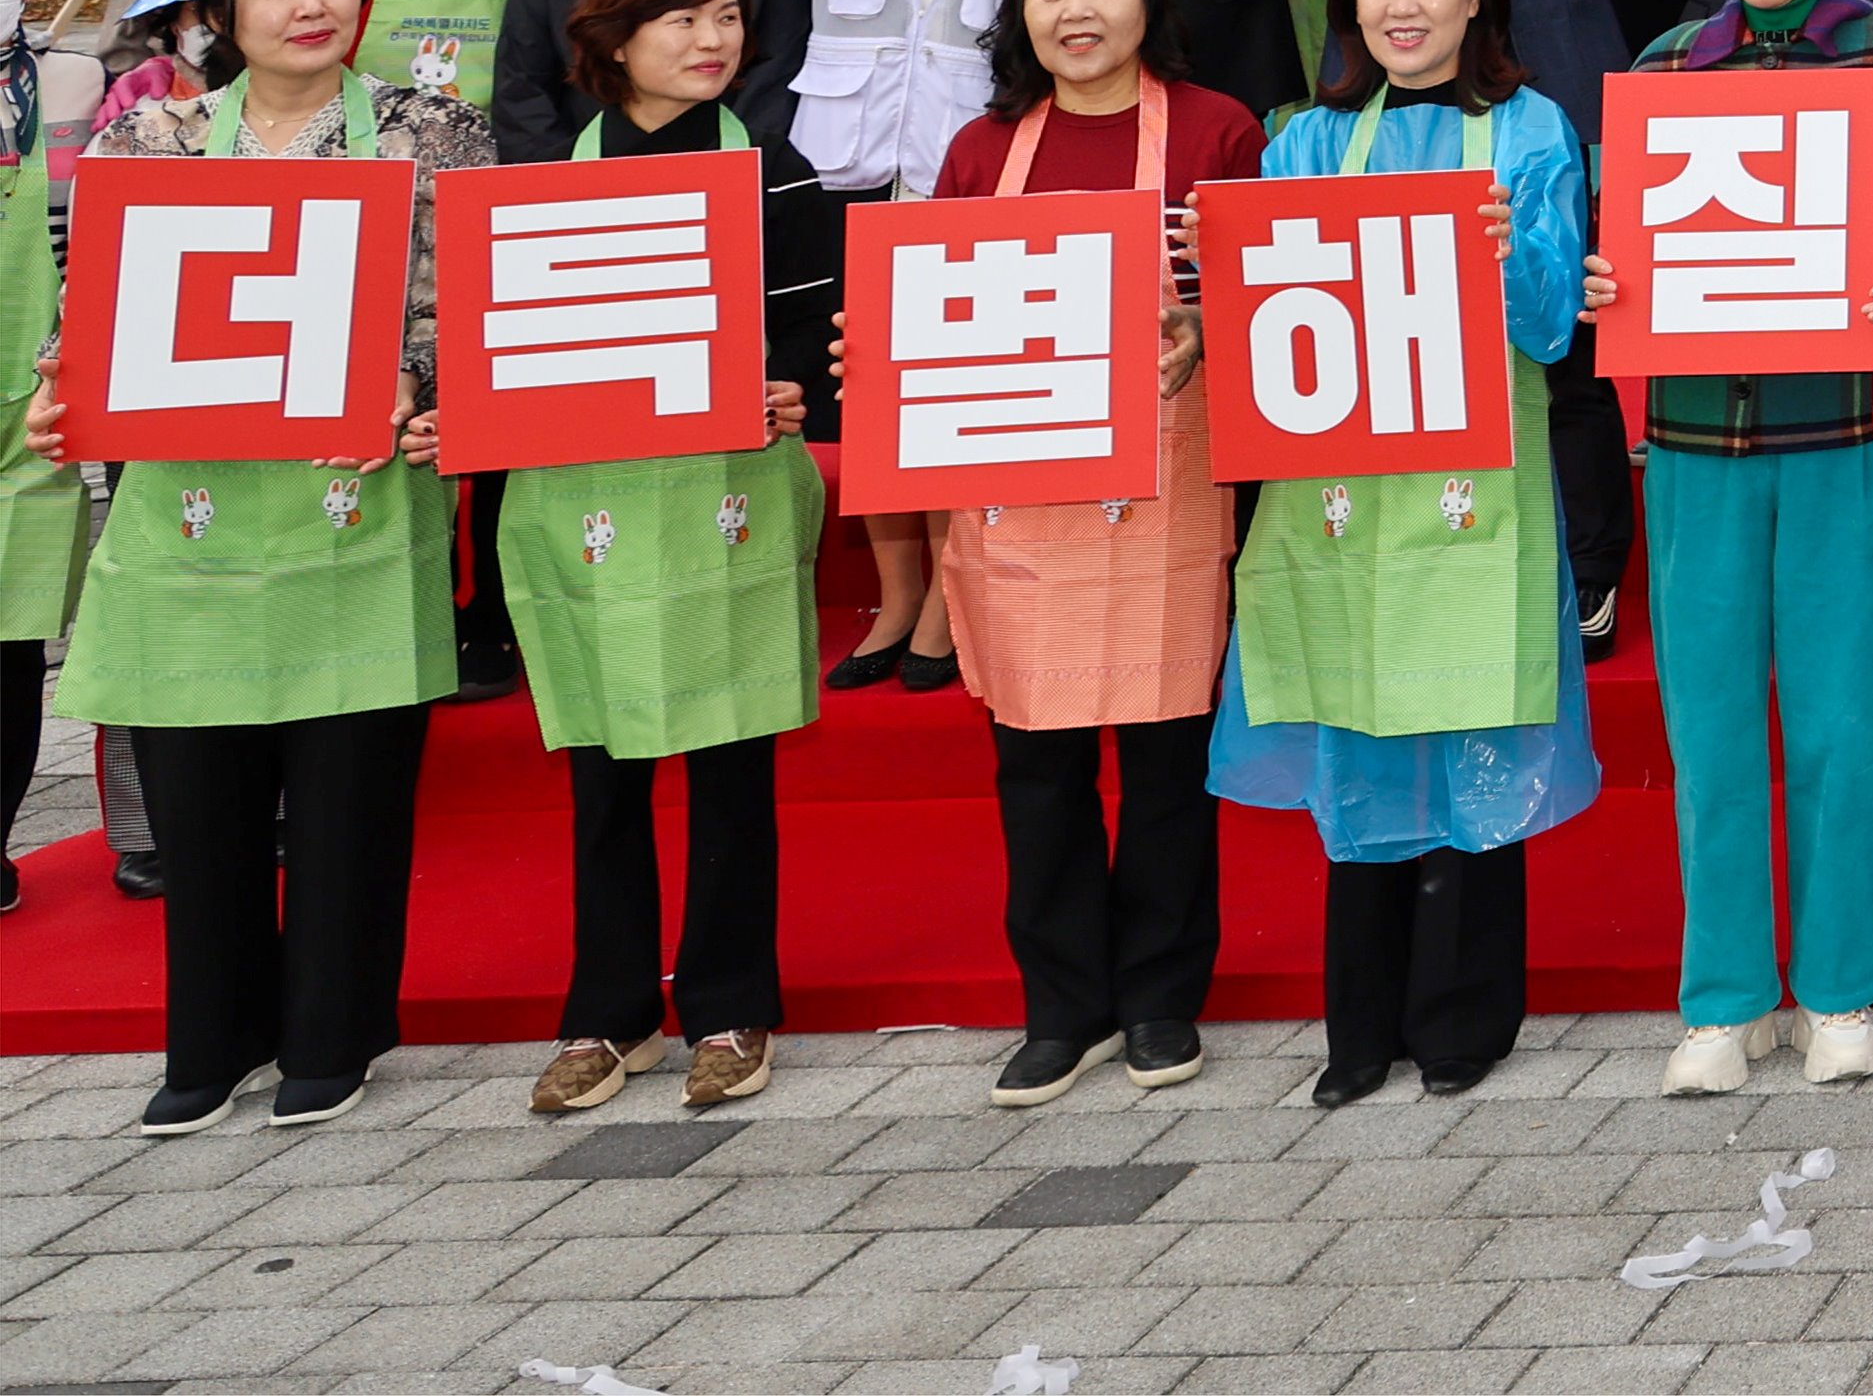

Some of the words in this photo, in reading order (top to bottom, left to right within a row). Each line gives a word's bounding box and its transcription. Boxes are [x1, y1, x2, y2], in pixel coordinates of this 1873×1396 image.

[108, 200, 360, 416] 더
[485, 193, 716, 415] 특
[892, 233, 1111, 468] 별
[1243, 214, 1466, 433] 해
[1643, 111, 1848, 333] 질
